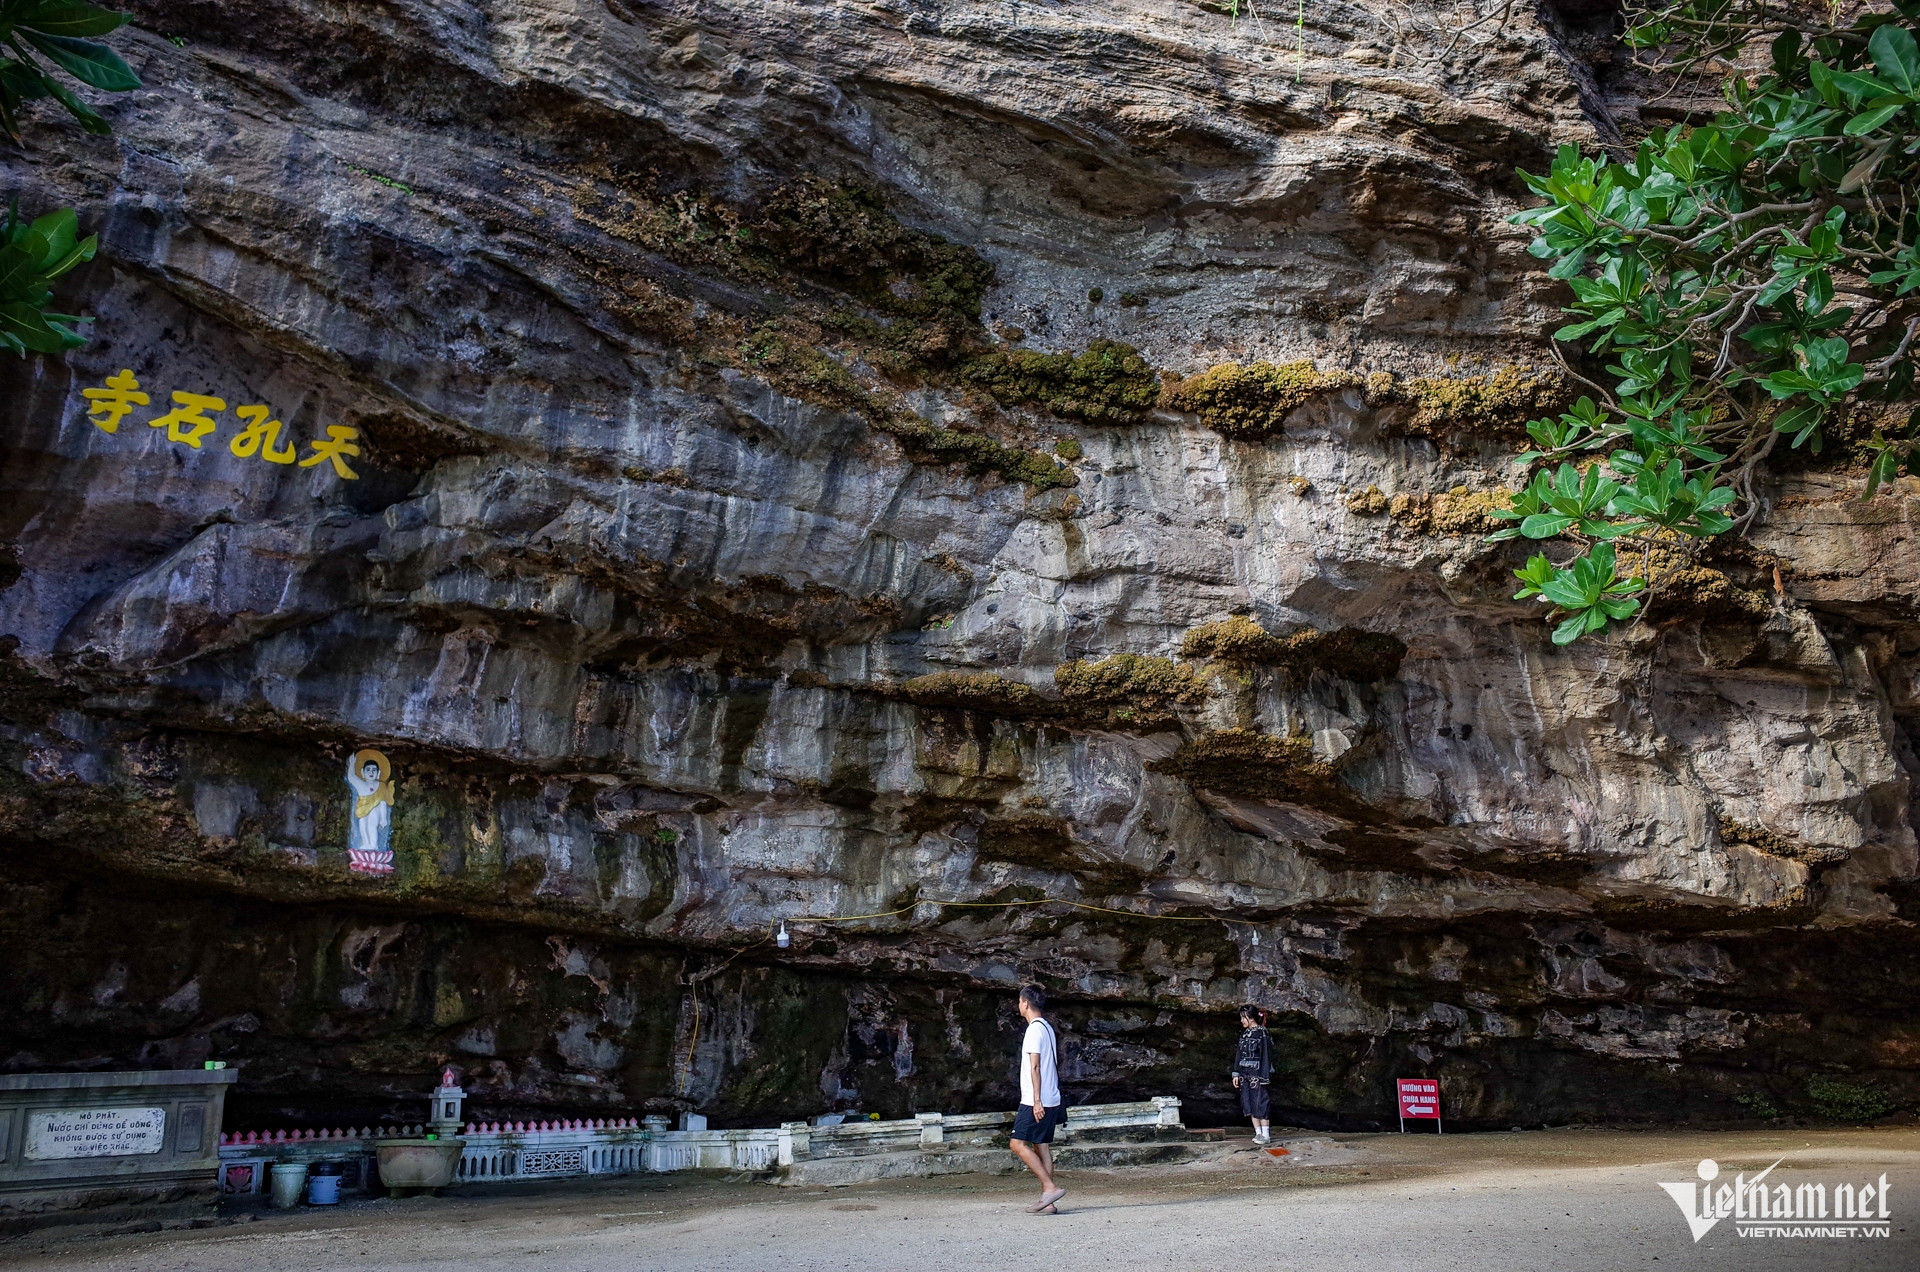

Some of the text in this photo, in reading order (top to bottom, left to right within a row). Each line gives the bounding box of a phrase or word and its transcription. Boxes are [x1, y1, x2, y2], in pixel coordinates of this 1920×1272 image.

[1423, 1084, 1435, 1092] VÀO
[1402, 1095, 1436, 1104] CHÙA HANG
